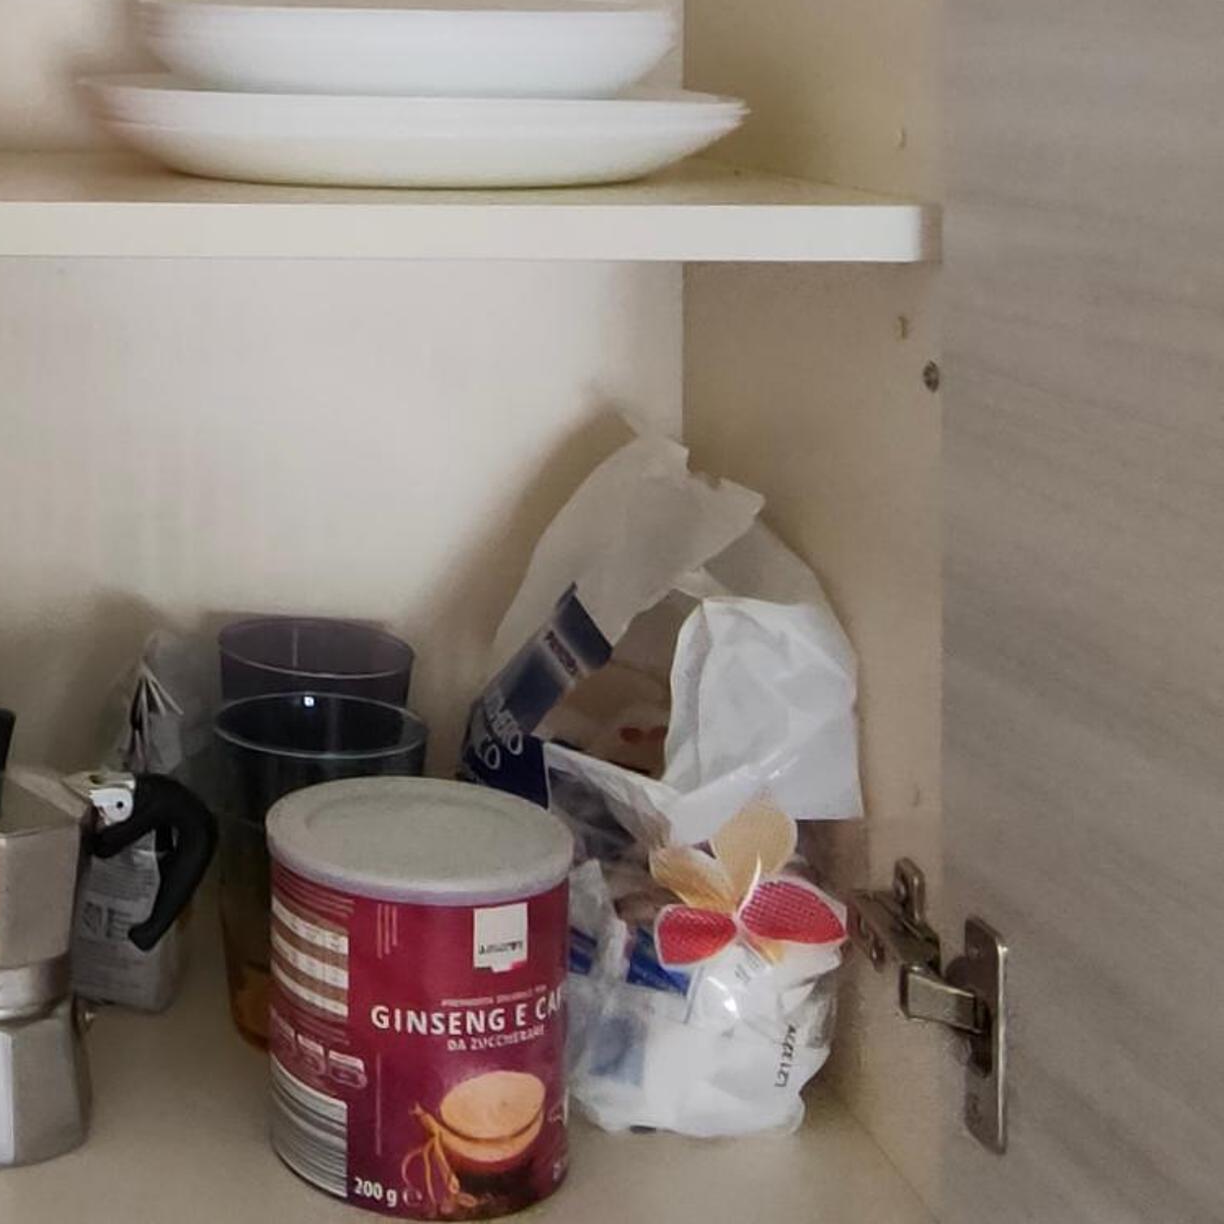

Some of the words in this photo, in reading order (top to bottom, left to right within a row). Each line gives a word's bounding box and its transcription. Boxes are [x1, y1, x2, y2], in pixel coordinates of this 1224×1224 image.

[371, 1005, 505, 1036] GINSENG
[515, 1004, 529, 1026] E
[446, 1039, 467, 1052] DA
[353, 1176, 383, 1201] 200
[386, 1188, 398, 1208] g
